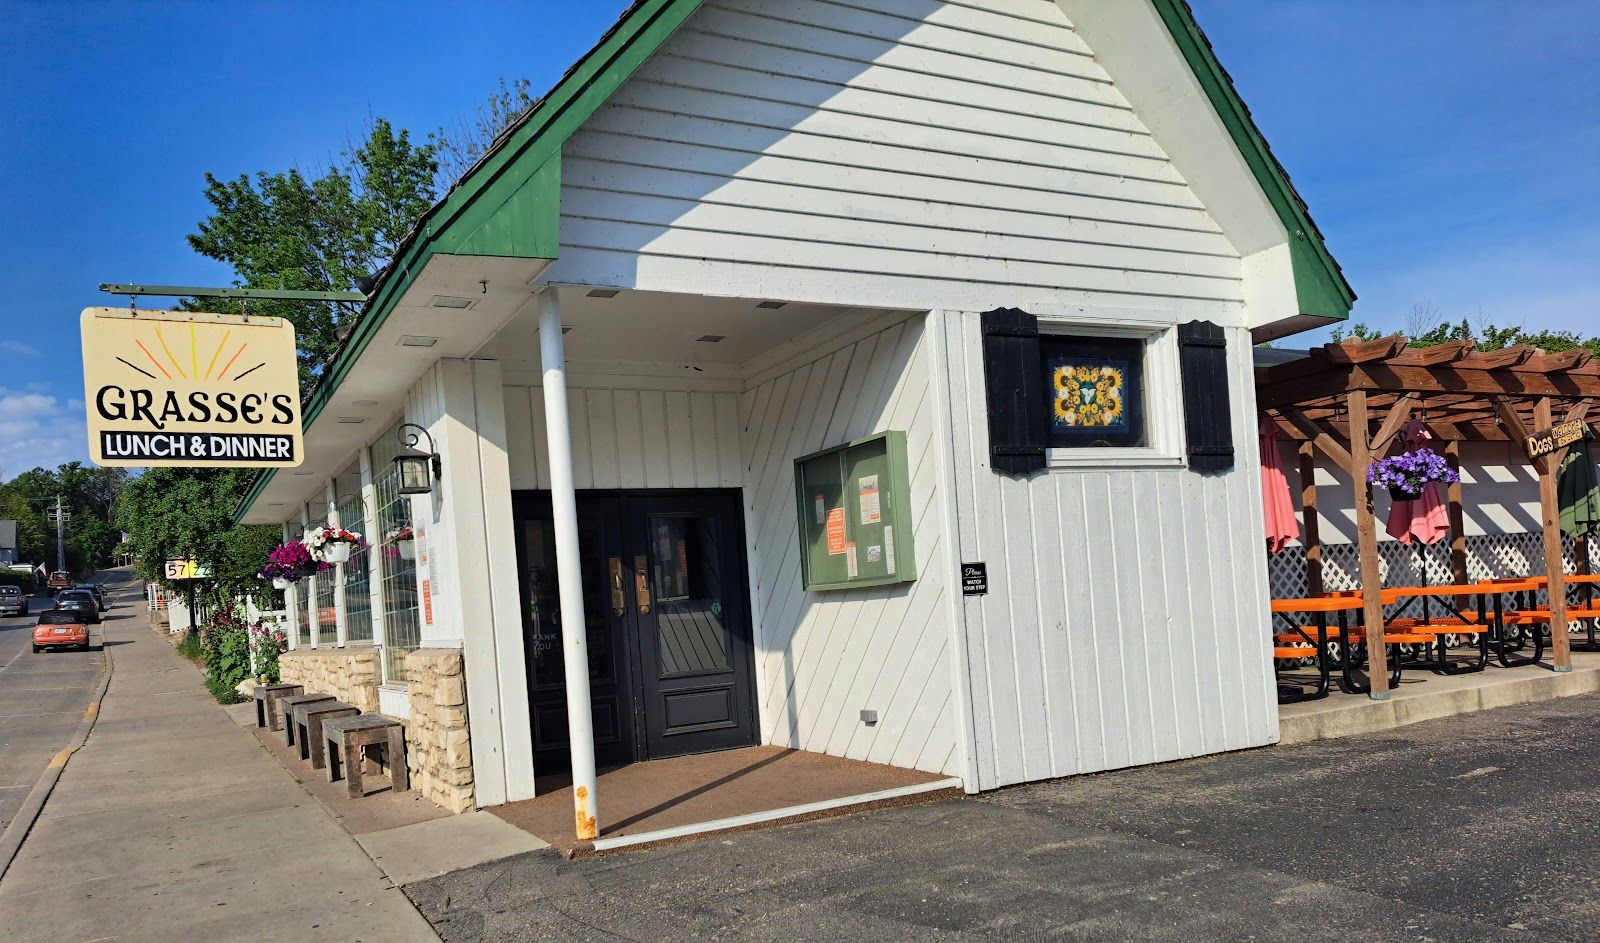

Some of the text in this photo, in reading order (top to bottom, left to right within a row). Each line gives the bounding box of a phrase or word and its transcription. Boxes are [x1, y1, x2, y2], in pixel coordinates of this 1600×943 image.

[96, 385, 294, 429] GRASSE'S
[105, 434, 291, 458] LUNCH & DINNER
[169, 565, 185, 576] 57
